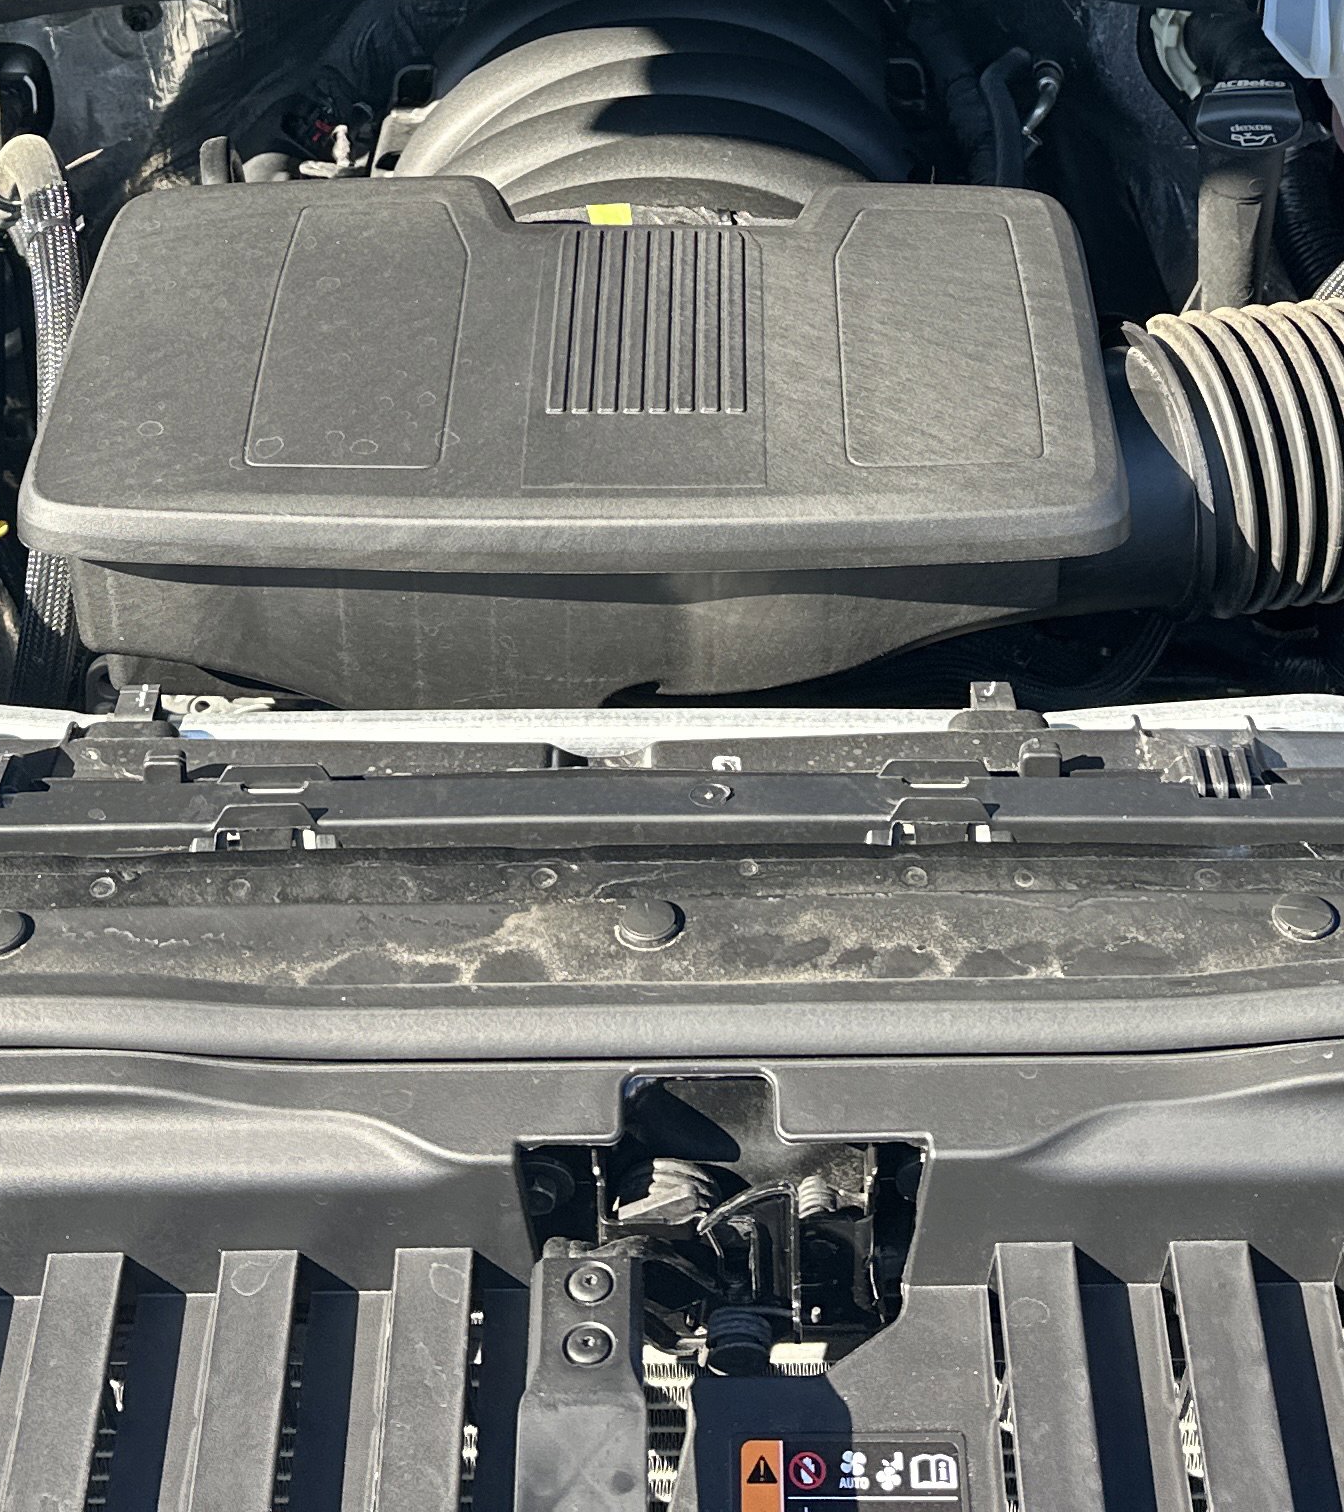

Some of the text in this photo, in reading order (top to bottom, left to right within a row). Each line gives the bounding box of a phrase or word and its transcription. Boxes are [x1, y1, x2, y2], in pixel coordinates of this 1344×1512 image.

[1213, 79, 1286, 92] ACDelco
[1230, 124, 1273, 133] dexos
[839, 1476, 870, 1490] AUTO
